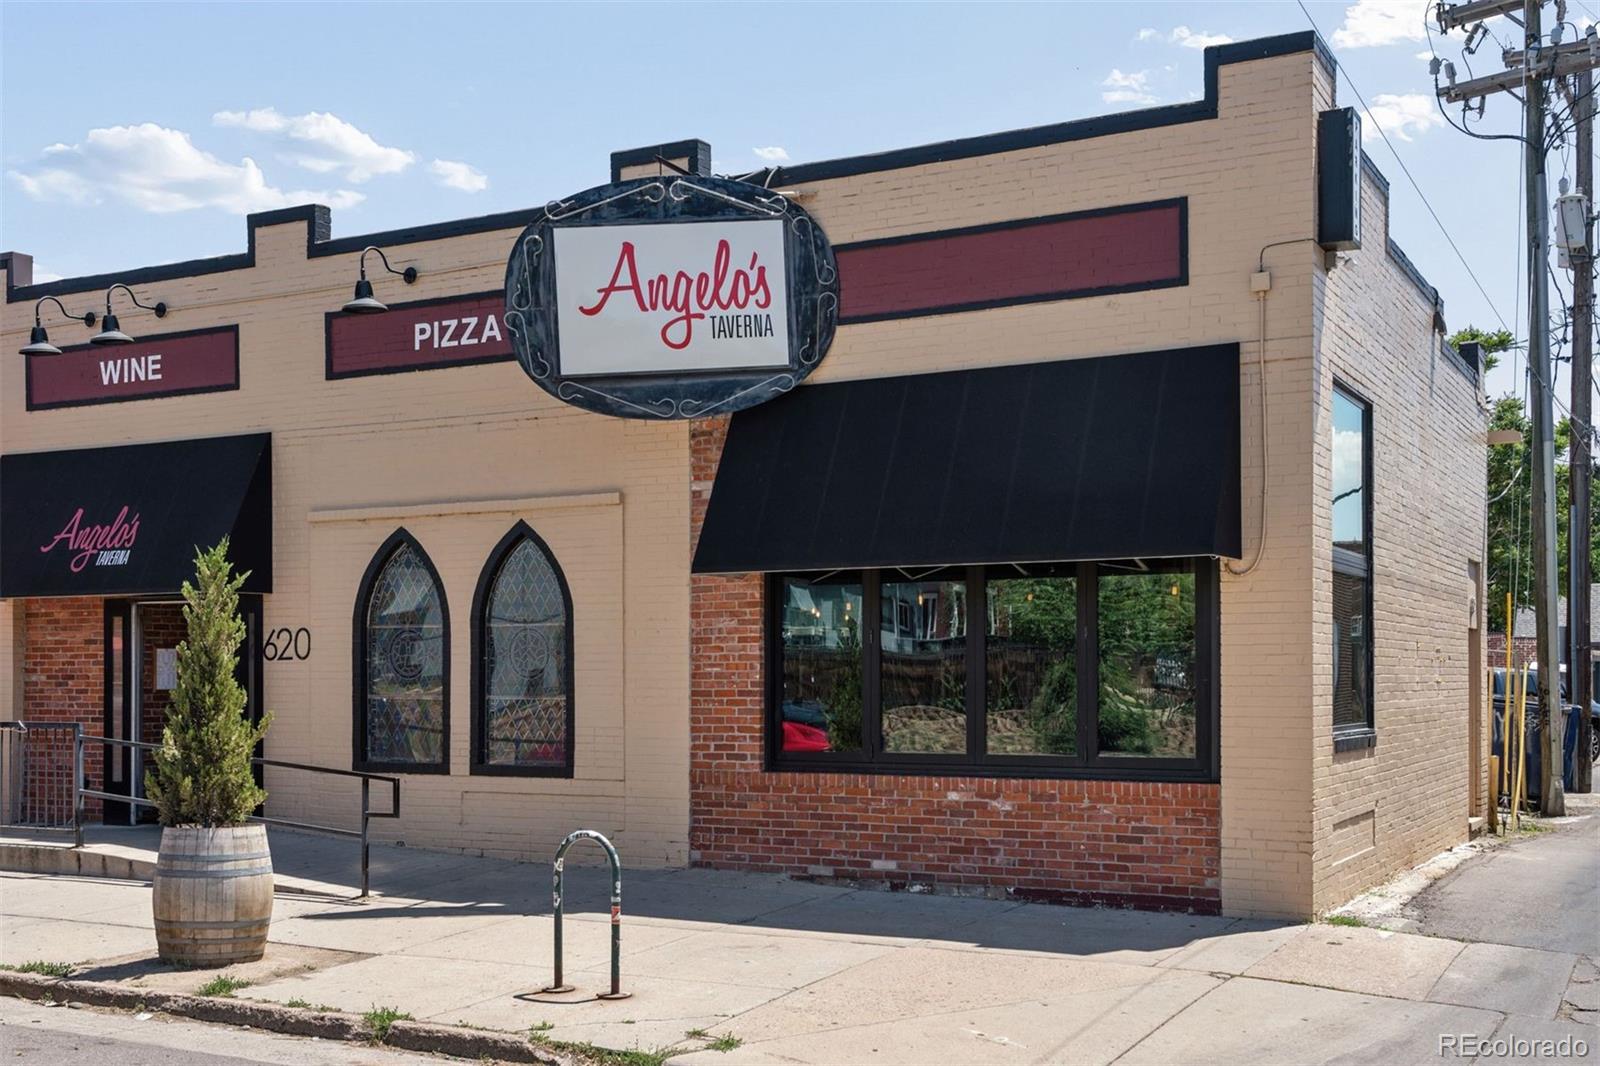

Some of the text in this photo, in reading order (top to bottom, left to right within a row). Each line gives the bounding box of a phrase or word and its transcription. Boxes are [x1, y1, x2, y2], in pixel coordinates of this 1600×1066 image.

[578, 239, 772, 350] Angelo's
[413, 314, 502, 351] PIZZA
[710, 314, 774, 340] TAVERNA
[99, 354, 163, 386] WINE
[40, 505, 140, 572] Angelo's
[96, 549, 131, 567] TAVERNA
[263, 627, 311, 661] 620
